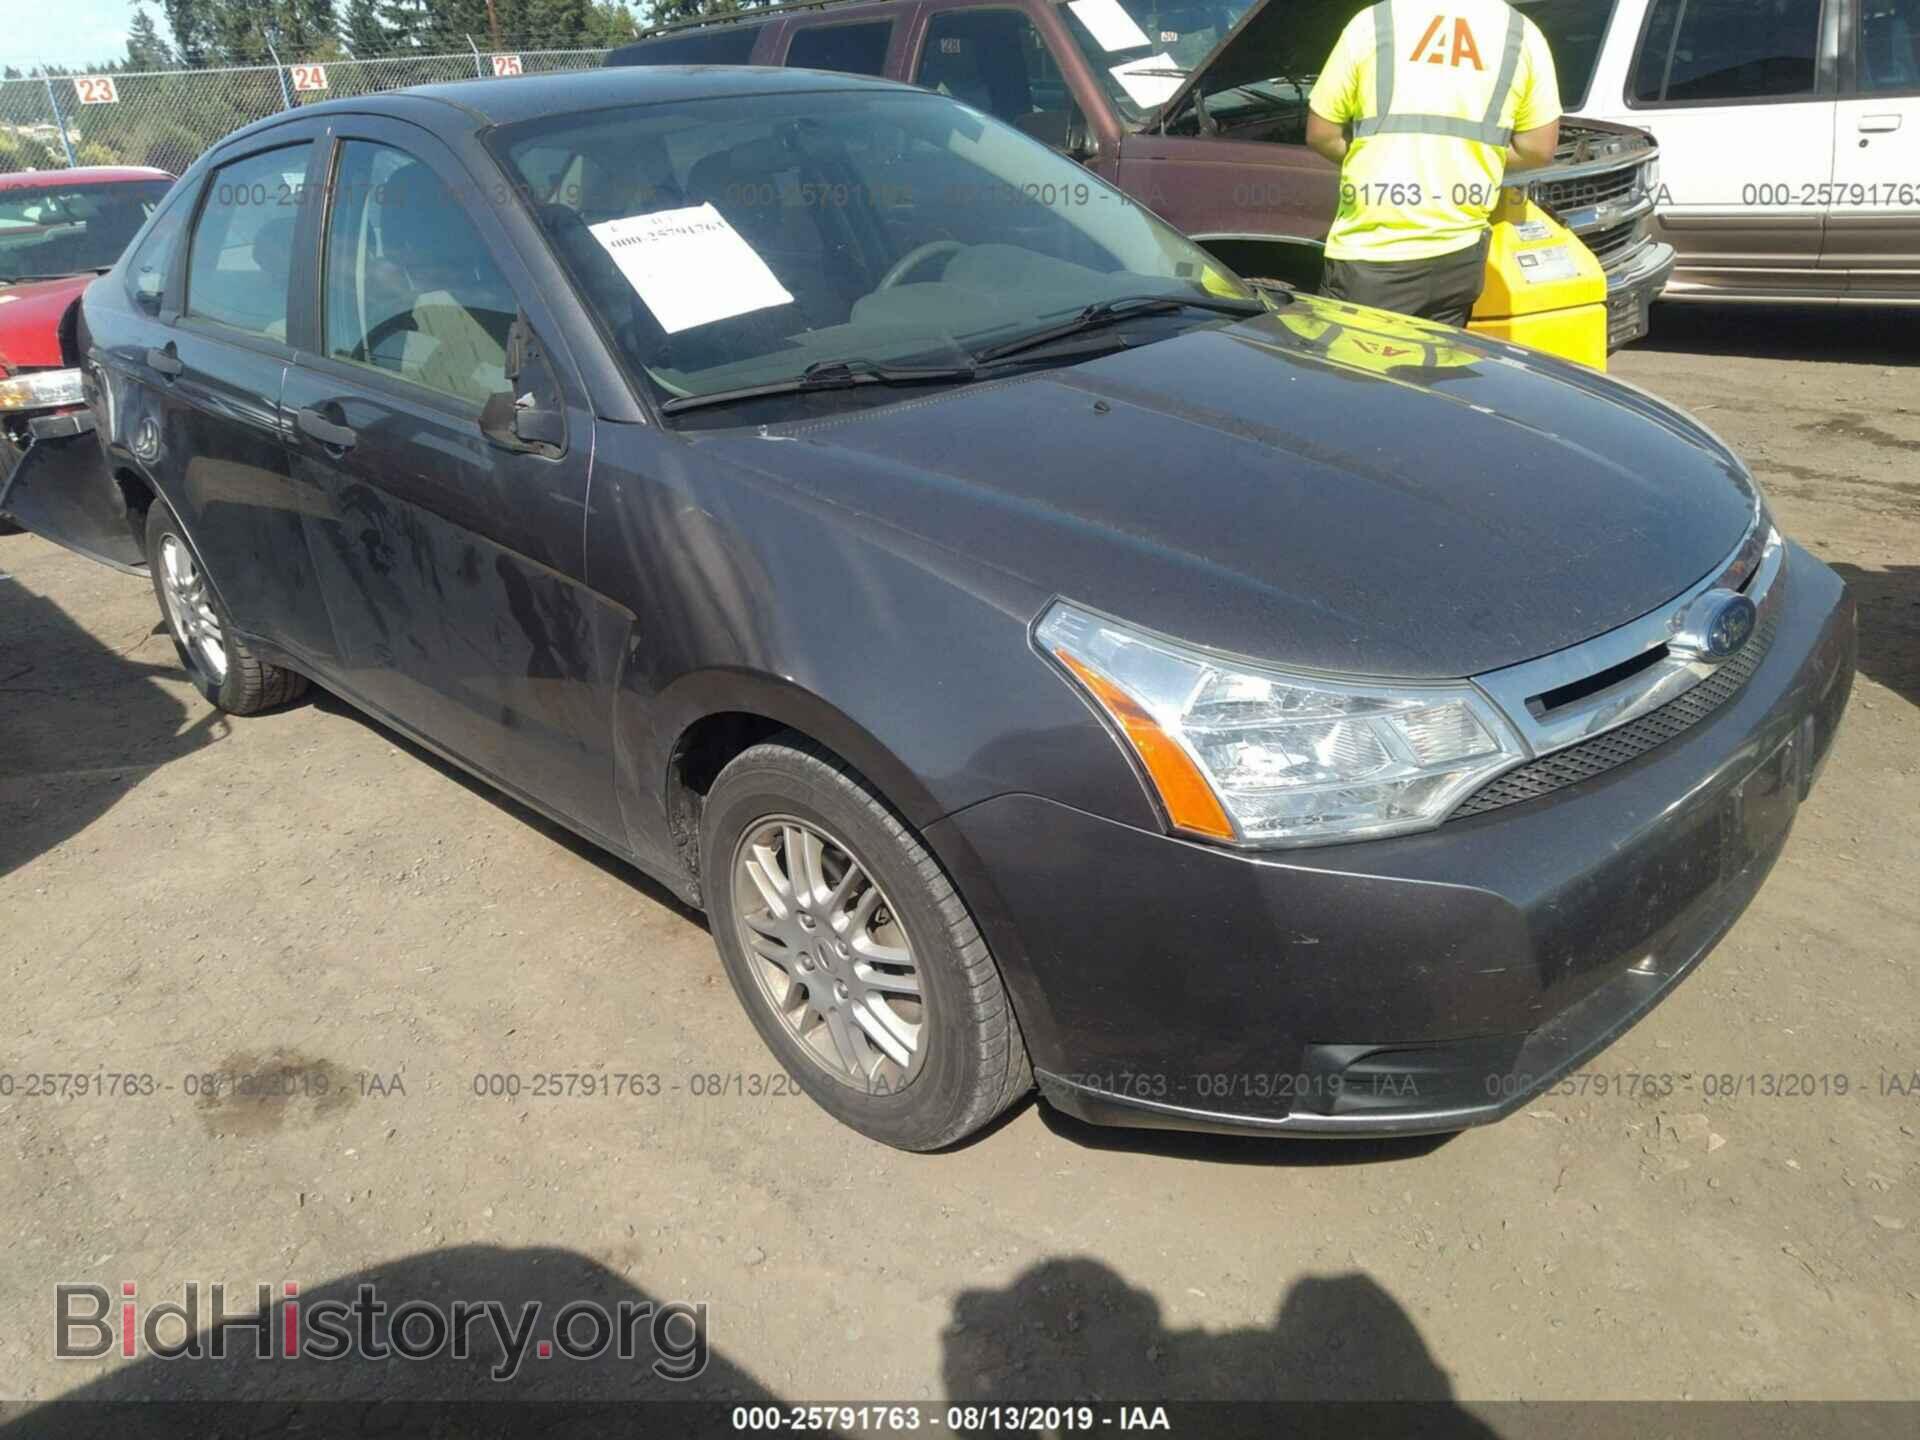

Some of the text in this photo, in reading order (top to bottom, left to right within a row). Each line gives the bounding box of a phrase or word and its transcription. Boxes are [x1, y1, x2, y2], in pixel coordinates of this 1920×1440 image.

[295, 68, 324, 88] 24
[495, 57, 519, 79] 25
[80, 79, 112, 102] 23
